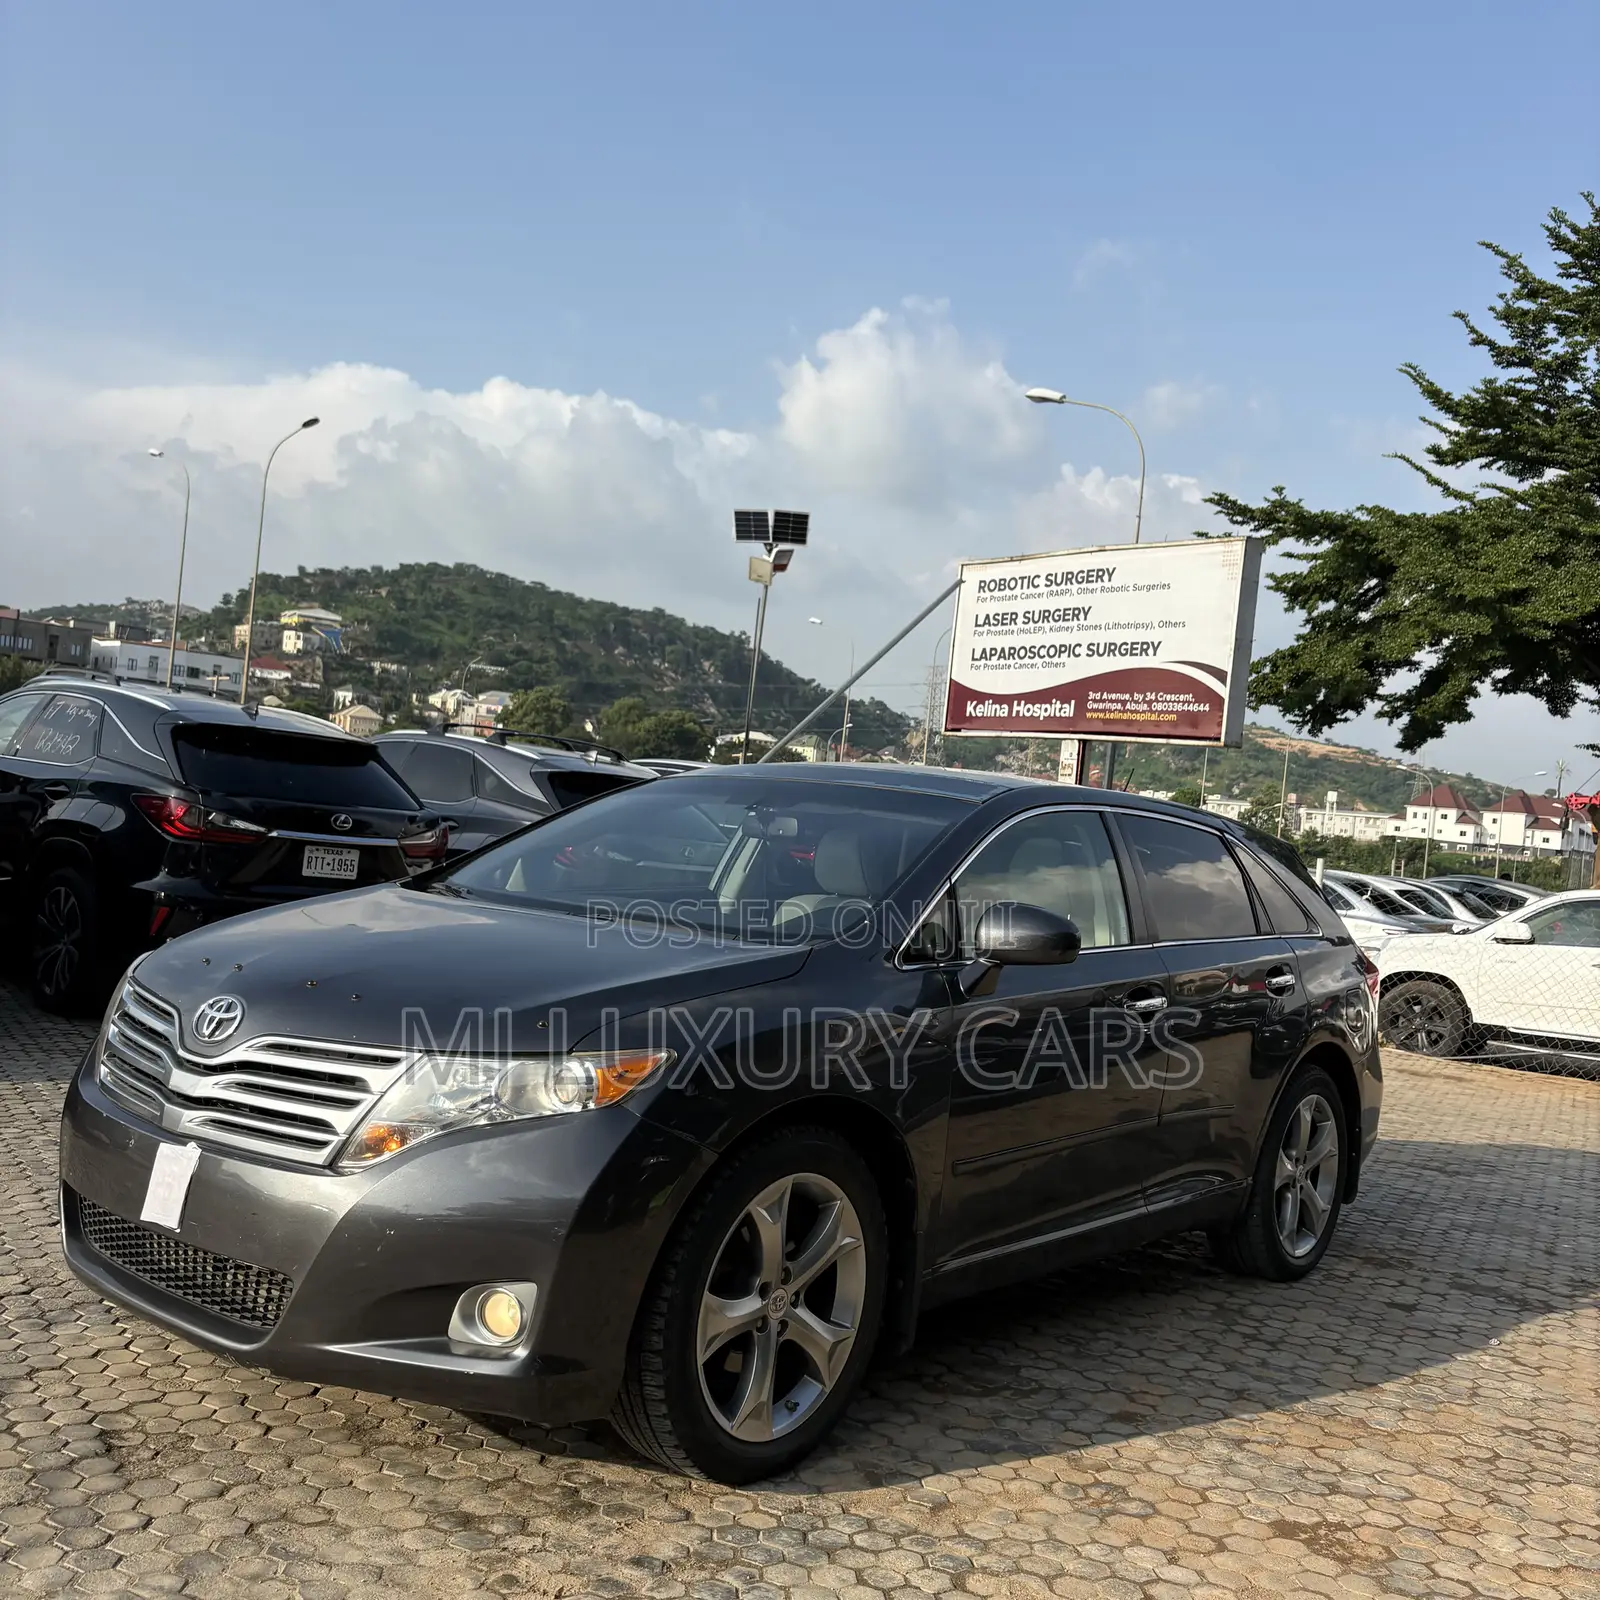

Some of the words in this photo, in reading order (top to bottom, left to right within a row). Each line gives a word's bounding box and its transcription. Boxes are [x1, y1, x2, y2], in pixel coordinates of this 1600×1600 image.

[978, 574, 1042, 593] ROBOTIC
[1044, 567, 1117, 588] SURGERY
[976, 595, 989, 603] For
[989, 593, 1018, 602] Prostate
[1020, 591, 1045, 600] Cancer
[1046, 588, 1075, 599] (RARP),
[1076, 586, 1098, 595] Other
[1100, 584, 1131, 594] Robotic
[1132, 581, 1171, 593] Surgeries
[974, 611, 1019, 628] LASER
[1022, 606, 1092, 625] SURGERY
[973, 629, 985, 637] For
[986, 628, 1015, 637] Prostate
[1016, 626, 1047, 637] (HoLEP),
[1049, 624, 1075, 634] Kidney
[1076, 623, 1103, 632] Stones
[1104, 620, 1156, 632] (Lithotripsy),
[1157, 620, 1186, 629] Others
[971, 643, 1083, 662] LAPAROSCOPIC
[1085, 640, 1162, 658] SURGERY
[970, 663, 982, 671] For
[983, 662, 1012, 671] Prostate
[1013, 661, 1040, 670] Cancer,
[1041, 660, 1066, 669] Others
[1088, 691, 1101, 700] 3rd
[1102, 692, 1132, 701] Avenue,
[1133, 692, 1143, 702] by
[1145, 692, 1156, 701] 34
[1157, 692, 1195, 702] Crescent,
[965, 699, 1009, 718] Kelina
[1012, 698, 1076, 721] Hospital
[1086, 701, 1124, 711] Gwarinpa,
[1151, 702, 1210, 712] 08033644644
[1086, 711, 1177, 721] www.kelinahospital.com
[322, 848, 344, 856] TEXAS
